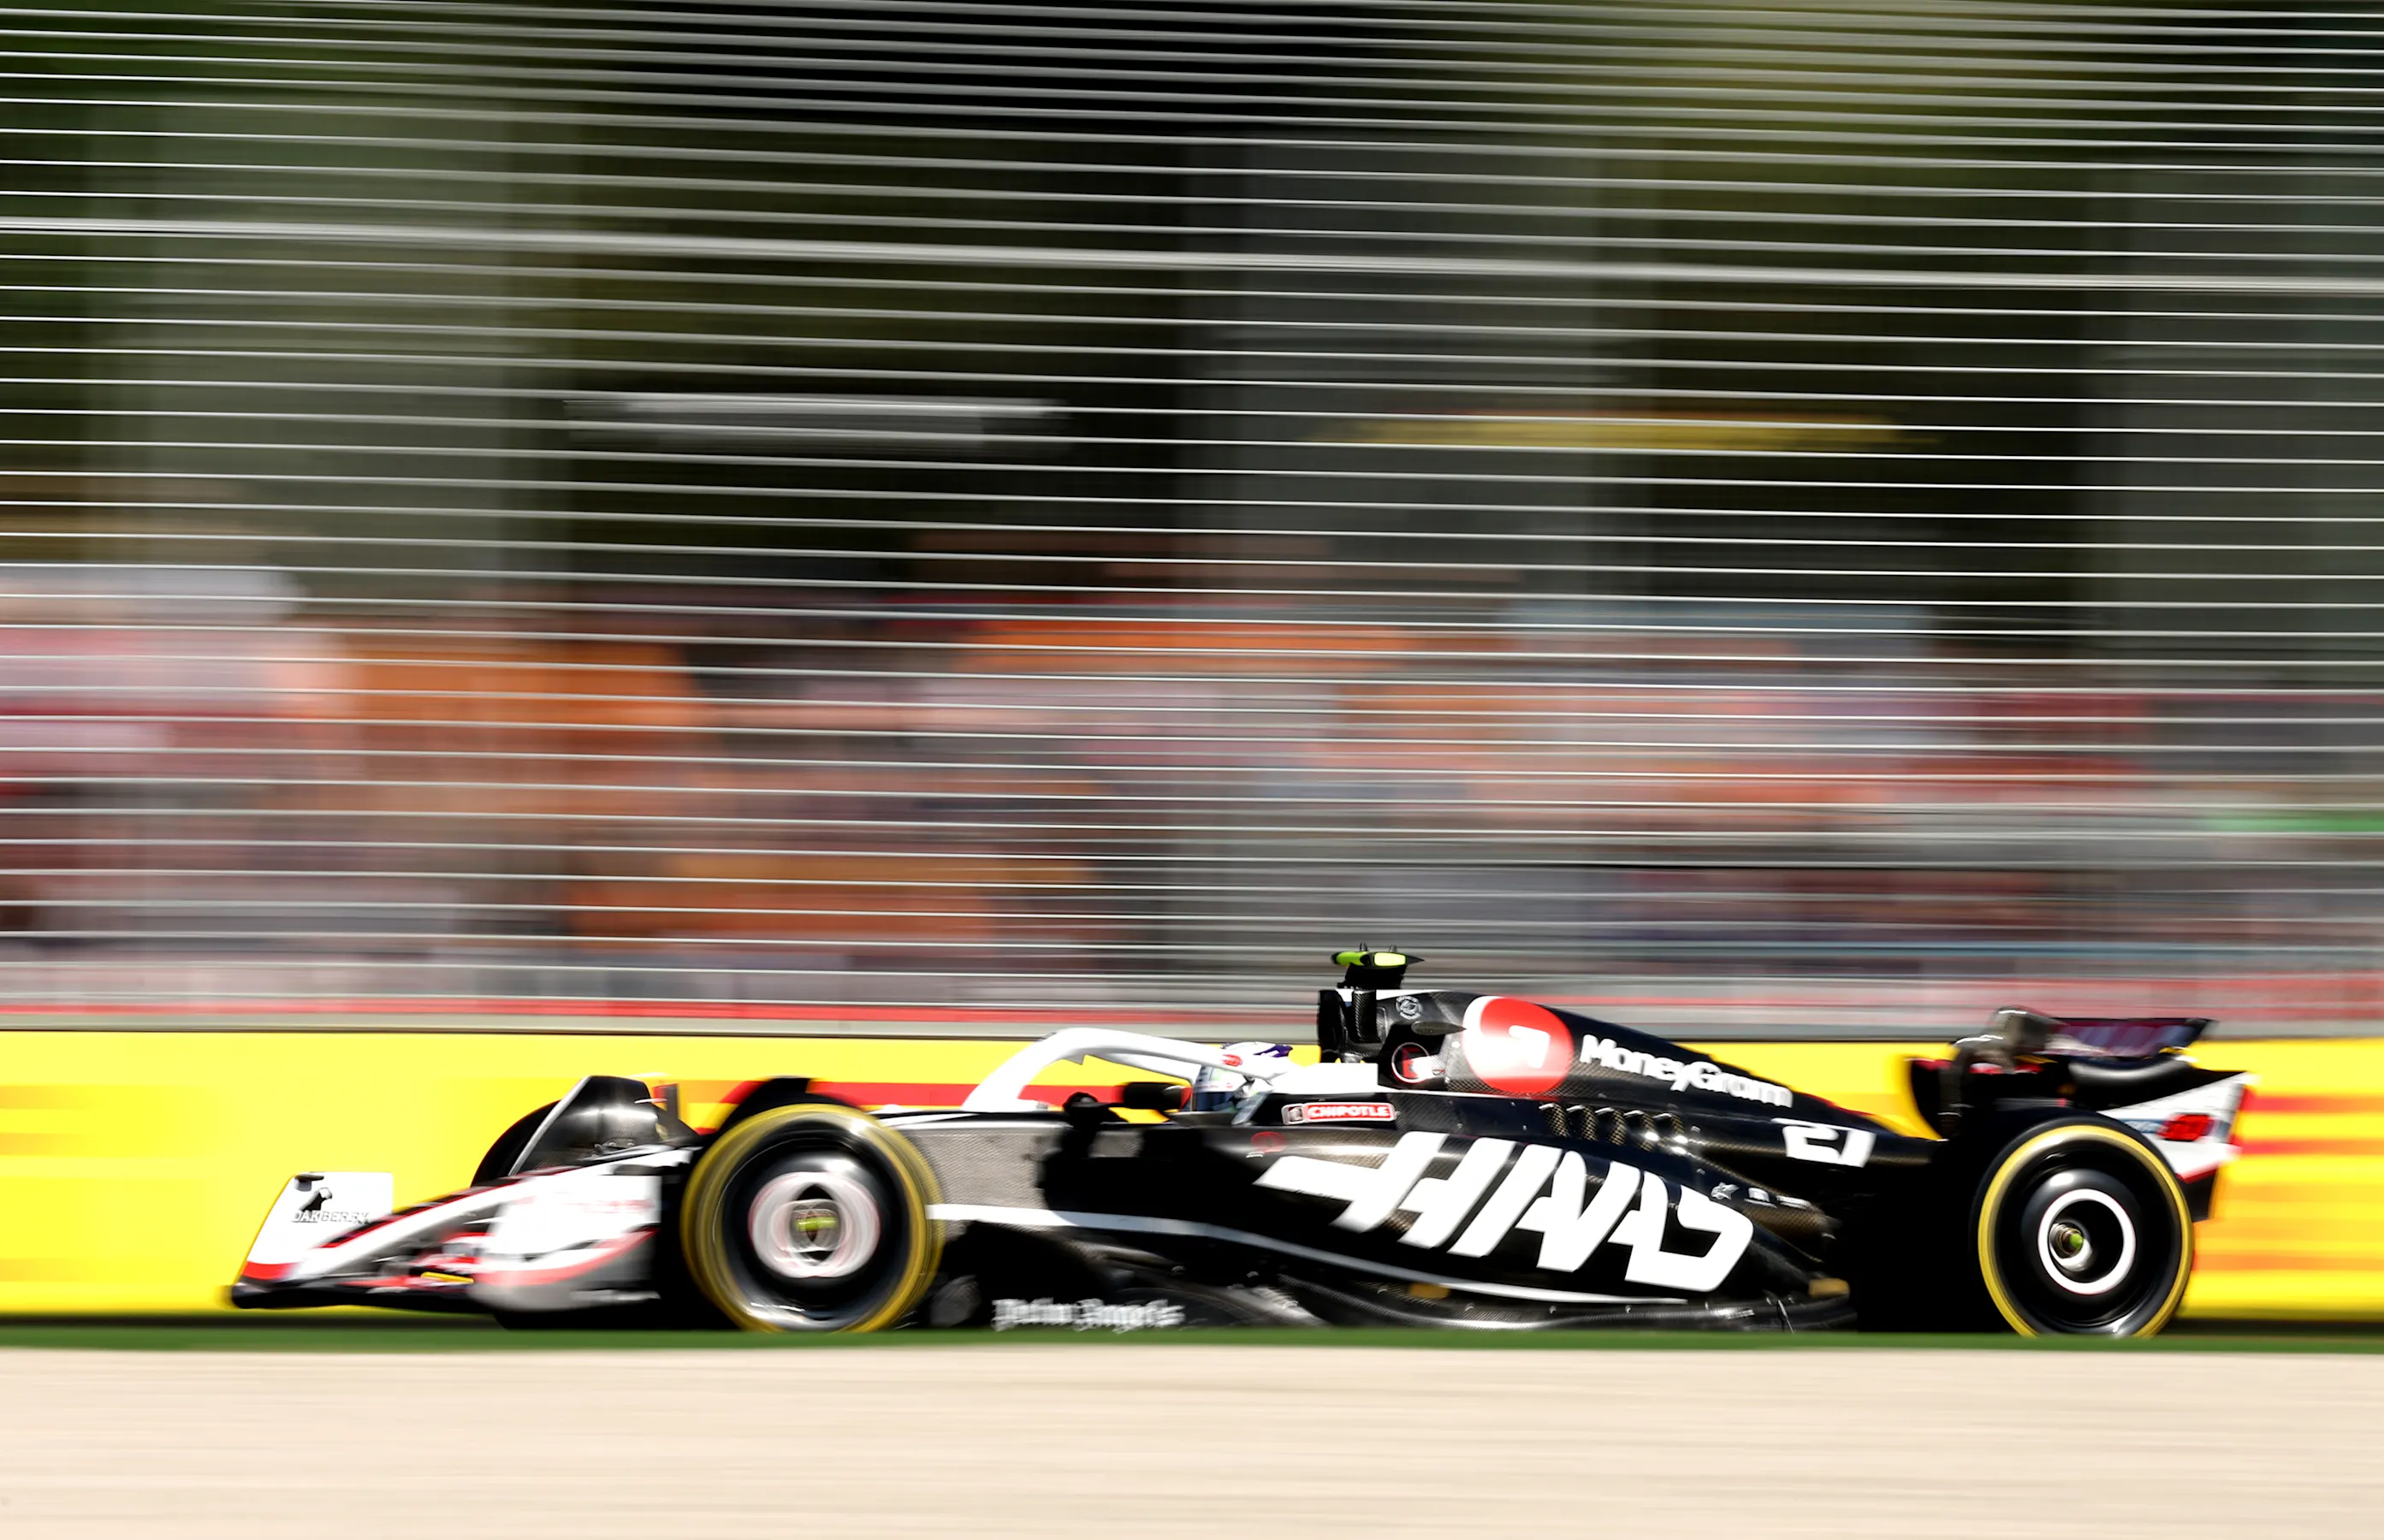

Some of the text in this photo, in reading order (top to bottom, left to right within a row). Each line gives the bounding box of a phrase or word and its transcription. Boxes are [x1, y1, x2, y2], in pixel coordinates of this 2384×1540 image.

[1580, 1034, 1793, 1108] MoneyGram
[1308, 1106, 1390, 1117] CHIPOTLE
[293, 1210, 370, 1224] OAKBERRY
[1253, 1131, 1754, 1292] HAAS
